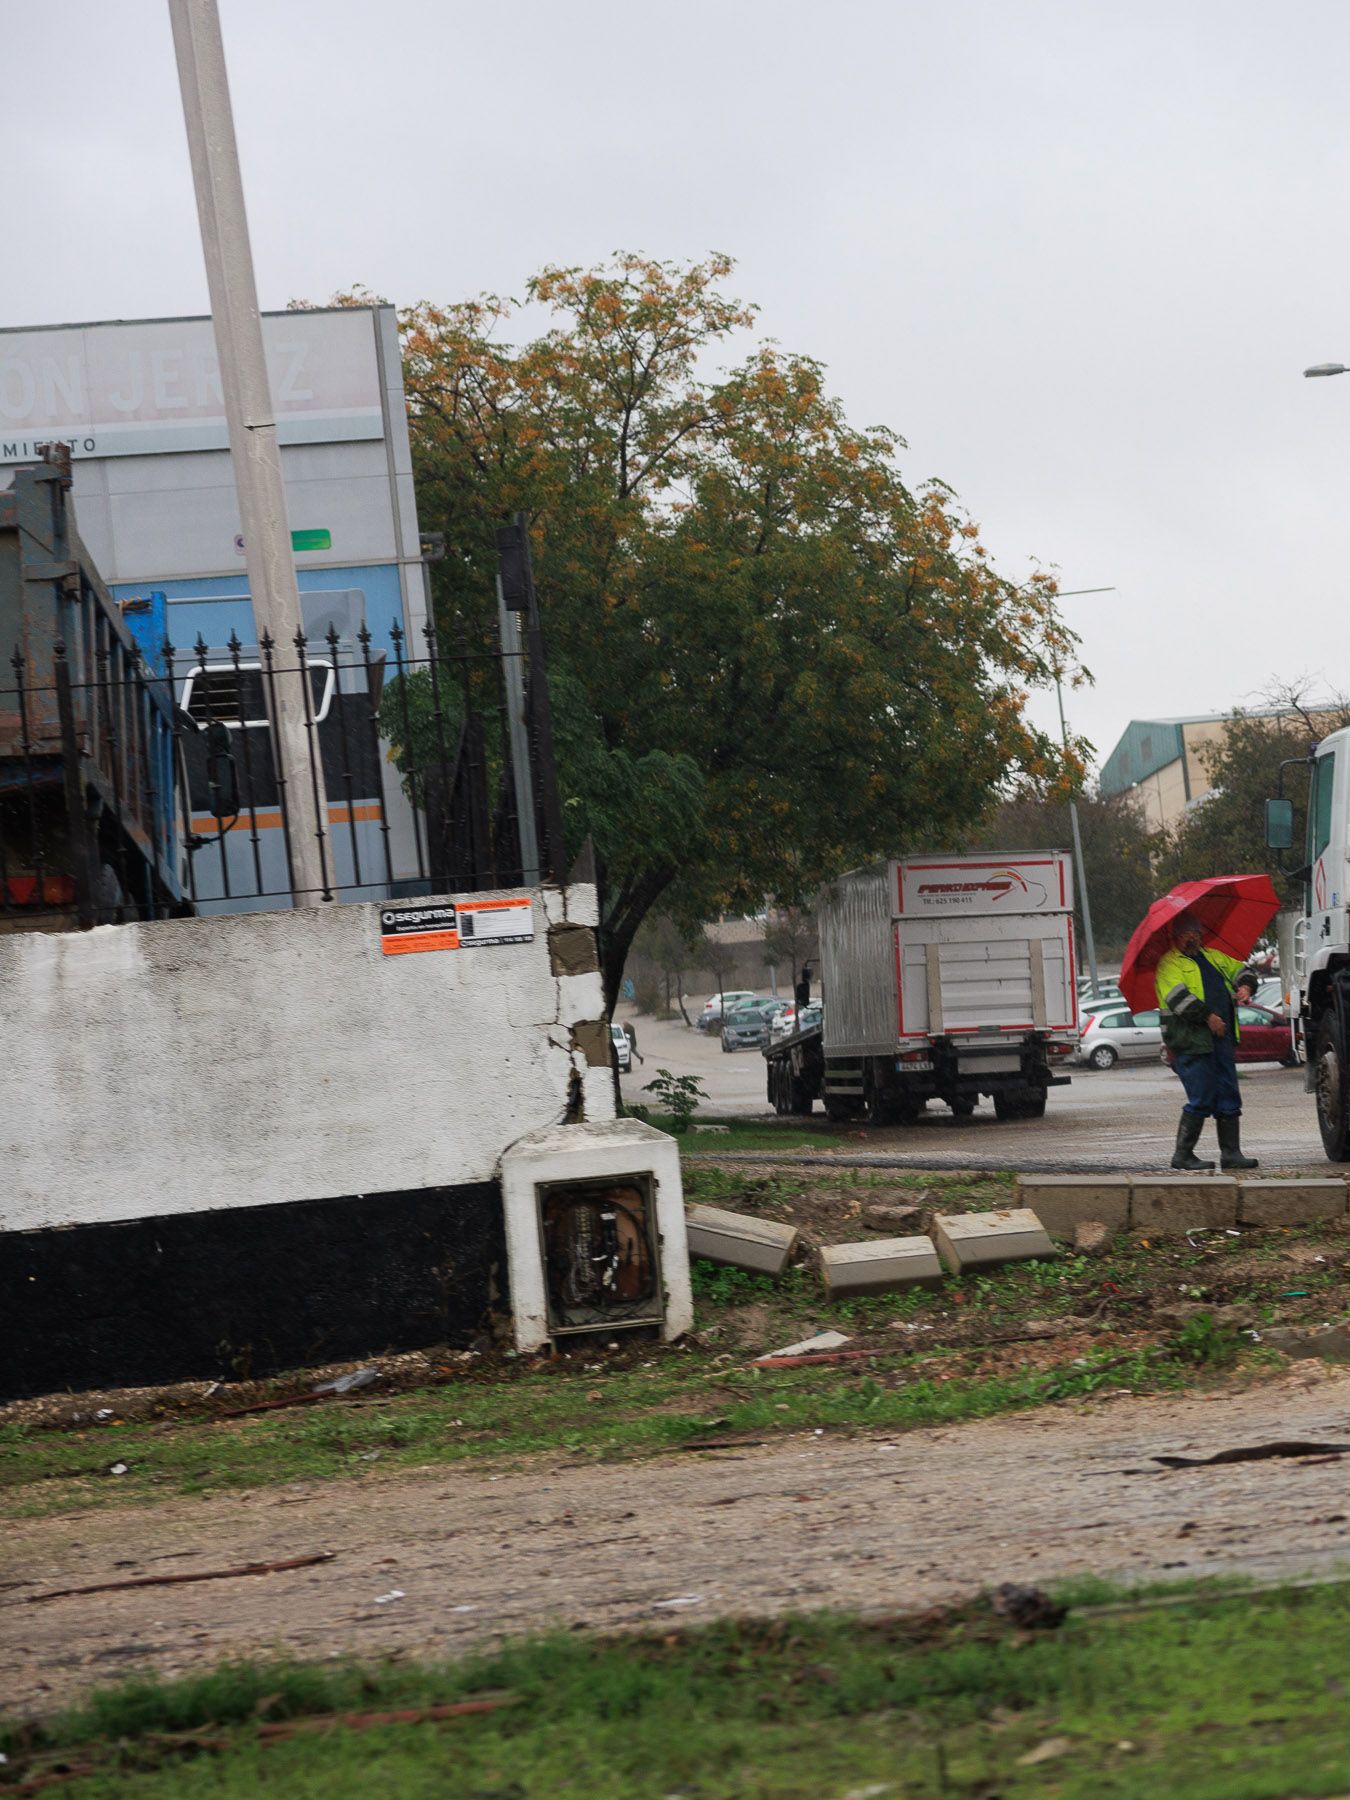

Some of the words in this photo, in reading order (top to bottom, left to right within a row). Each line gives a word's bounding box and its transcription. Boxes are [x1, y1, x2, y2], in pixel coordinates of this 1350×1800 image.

[107, 342, 314, 412] JERZ
[3, 437, 96, 458] MIETO
[395, 908, 455, 924] segurma
